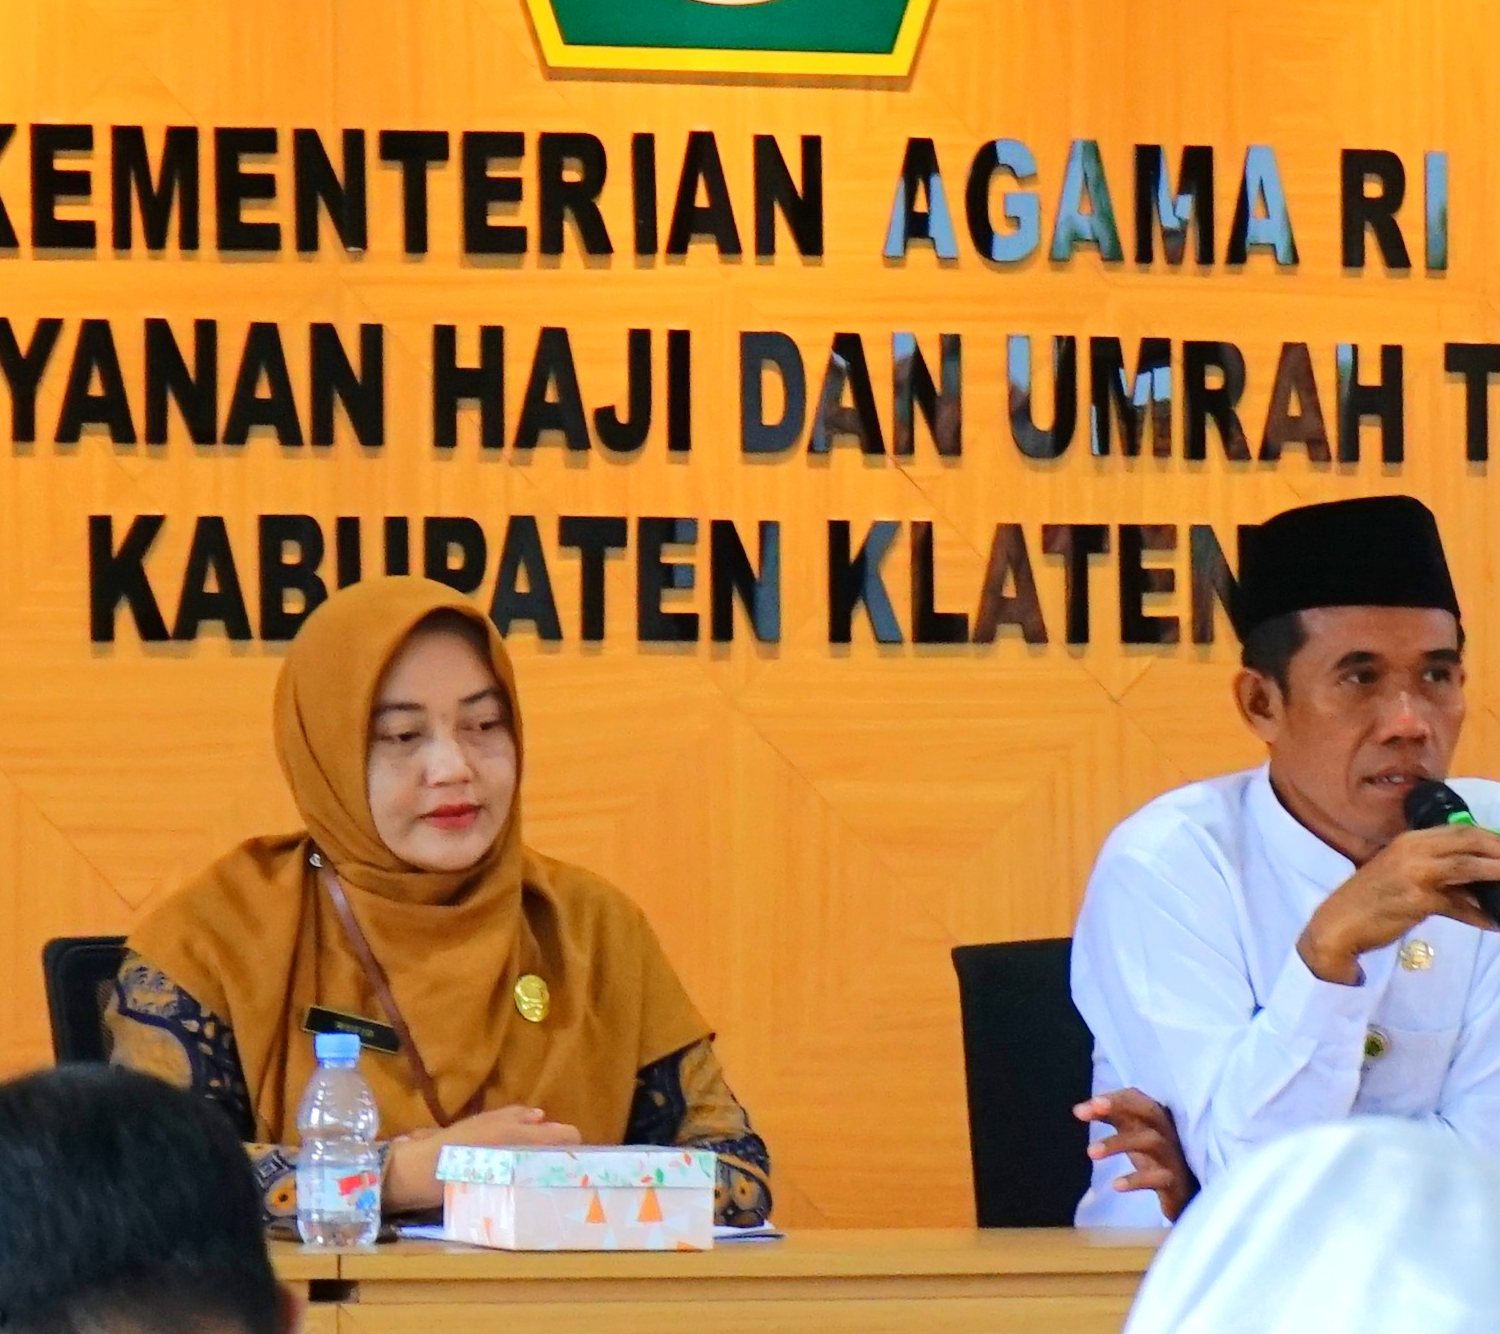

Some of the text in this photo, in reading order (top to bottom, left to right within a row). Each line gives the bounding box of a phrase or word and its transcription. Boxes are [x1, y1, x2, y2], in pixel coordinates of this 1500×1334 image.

[882, 136, 1300, 267] AGAMA
[1341, 148, 1448, 272] RI
[432, 323, 692, 454] HAJI
[738, 330, 963, 458] DAN
[1007, 334, 1405, 465] UMRAH
[827, 519, 1264, 646] KLATEN
